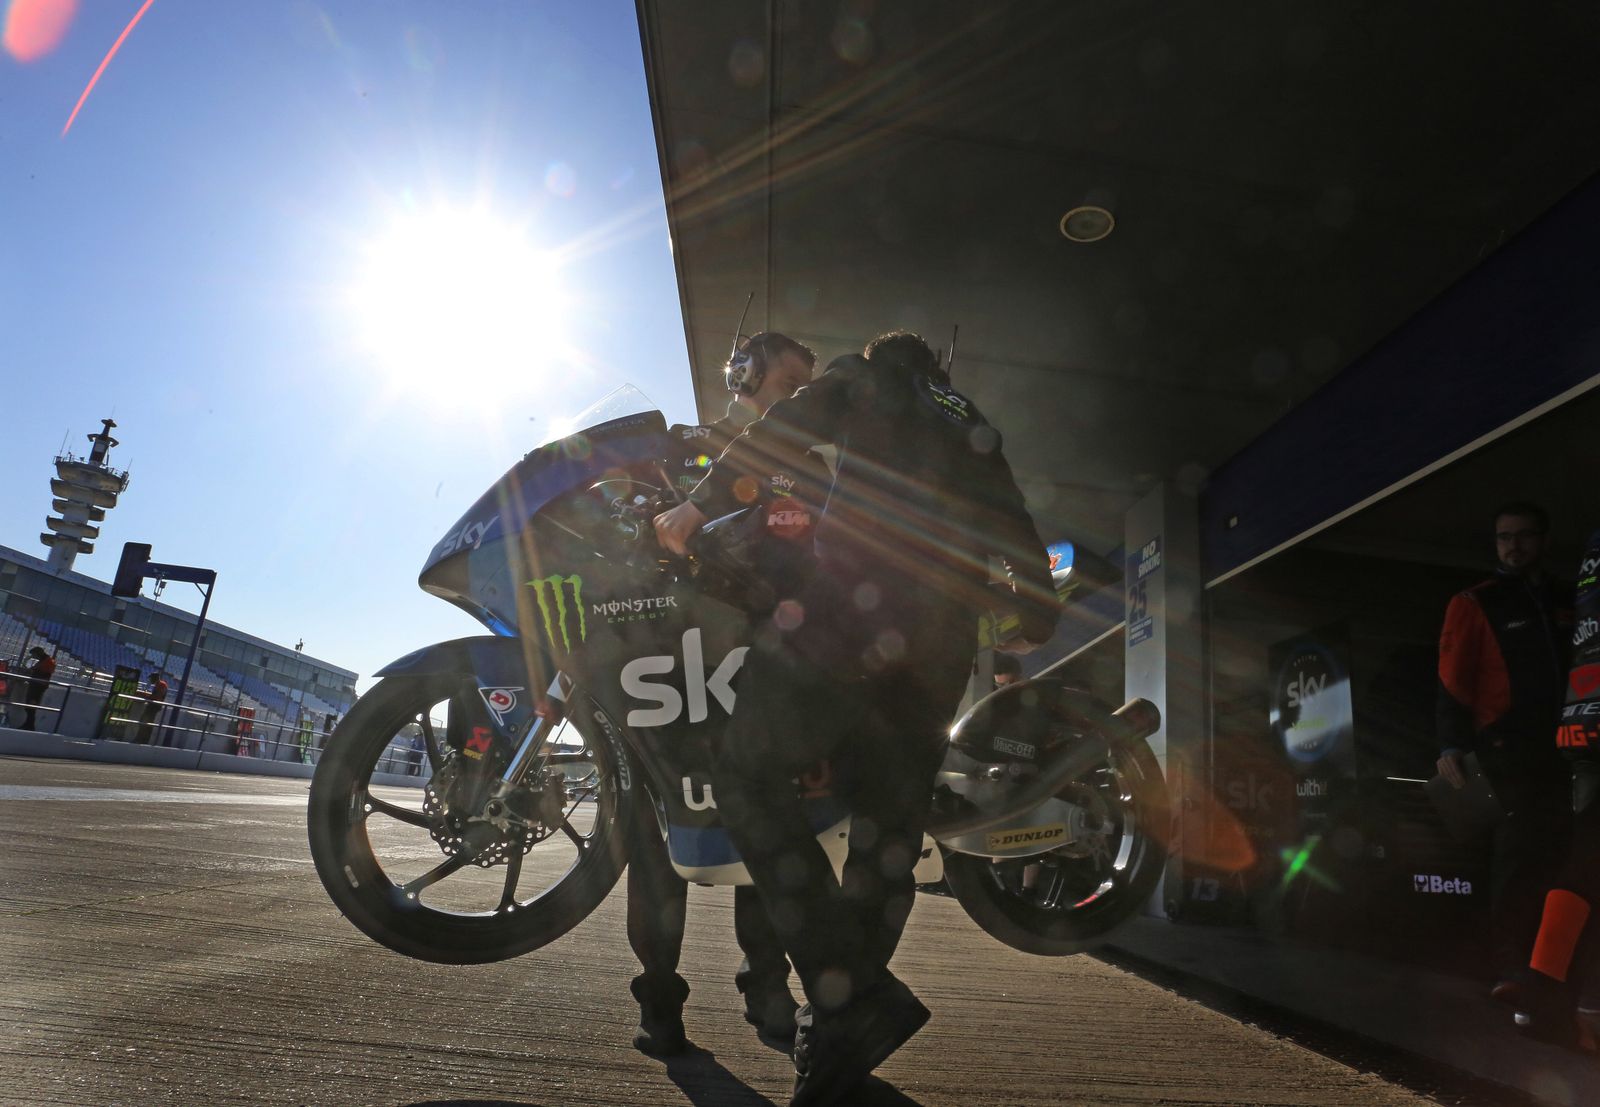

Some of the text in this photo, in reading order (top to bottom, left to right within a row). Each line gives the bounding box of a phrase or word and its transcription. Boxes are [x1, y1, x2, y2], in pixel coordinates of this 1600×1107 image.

[771, 475, 796, 491] sky
[768, 510, 811, 526] KTM
[1142, 540, 1157, 561] NO
[592, 596, 678, 616] MONSTER
[1129, 579, 1147, 625] 25
[607, 612, 668, 624] ENERGY
[1286, 671, 1327, 707] sky
[1002, 827, 1064, 846] DUNLOP
[1430, 875, 1473, 895] Beta
